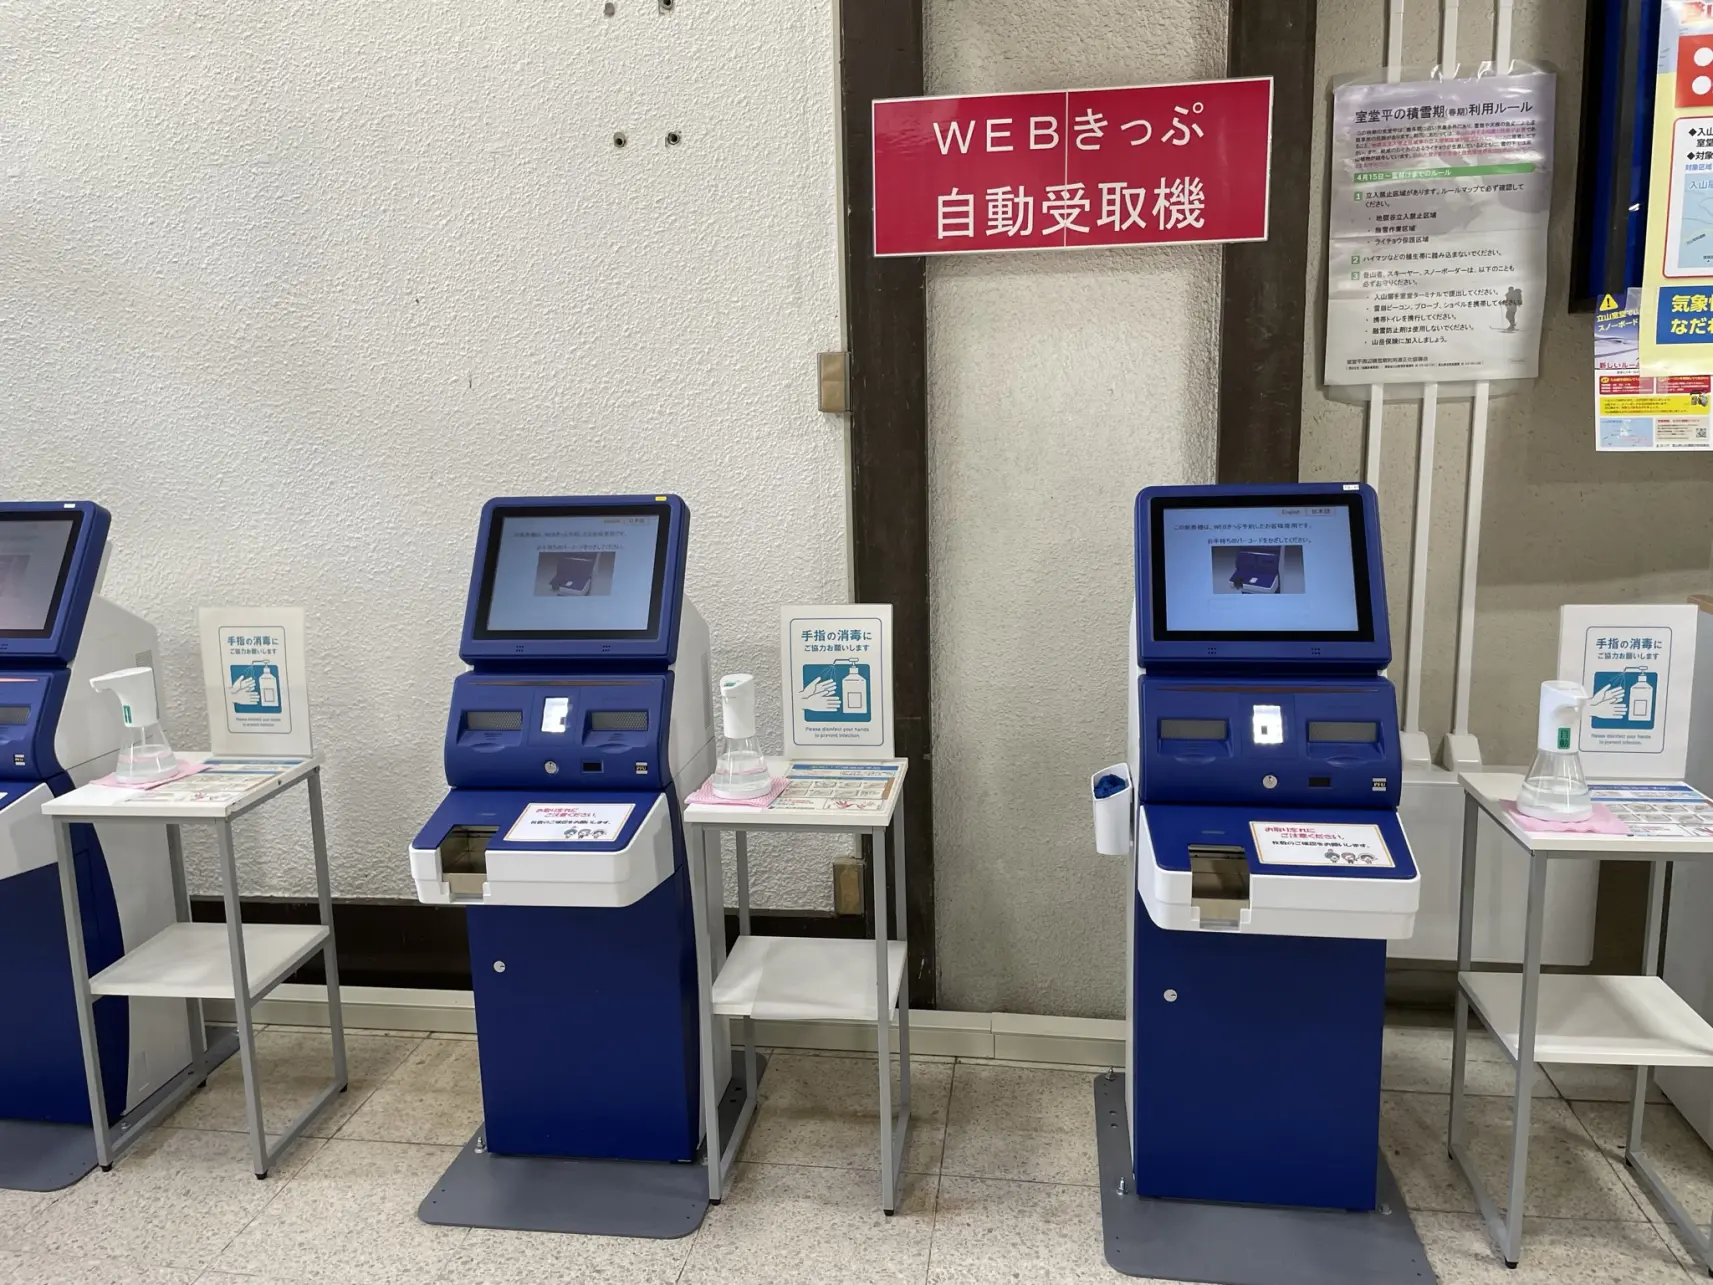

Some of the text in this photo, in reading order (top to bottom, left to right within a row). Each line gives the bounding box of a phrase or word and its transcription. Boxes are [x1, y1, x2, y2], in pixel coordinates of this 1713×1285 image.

[933, 101, 1204, 155] WEBきっぷ
[936, 176, 1206, 240] 自動受取機
[1365, 200, 1390, 208] ください。
[227, 635, 279, 646] 手指の消毒に
[801, 629, 872, 642] 手指の消毒に
[804, 644, 870, 652] ご協力お願いします
[1596, 637, 1663, 650] 手指の消毒に
[1597, 651, 1660, 660] ご協力お願いします
